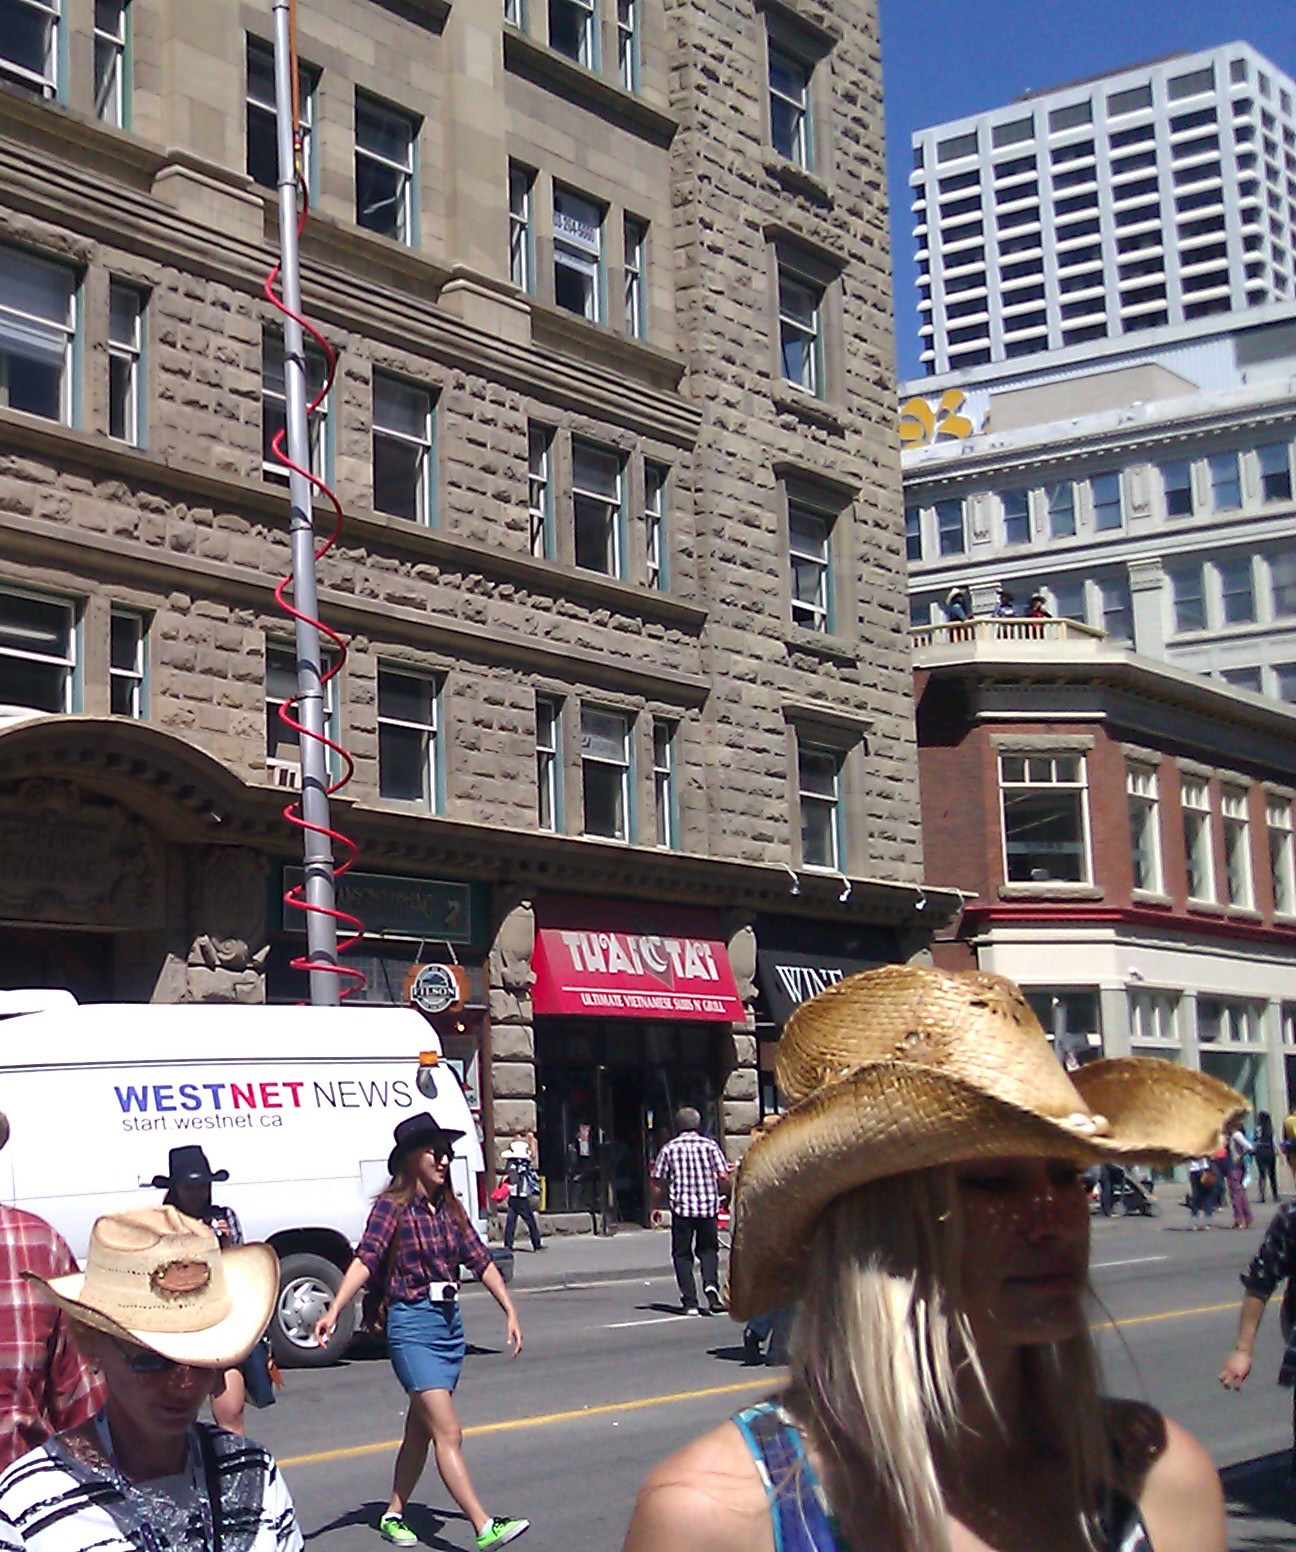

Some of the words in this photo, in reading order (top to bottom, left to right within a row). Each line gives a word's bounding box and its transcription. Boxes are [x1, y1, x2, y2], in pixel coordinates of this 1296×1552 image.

[581, 992, 624, 1007] ULTIMATE
[623, 995, 673, 1009] VIETNAMESE
[114, 1082, 304, 1112] WESTNET
[314, 1080, 413, 1108] NEWS
[122, 1113, 283, 1132] start.westnet.ca
